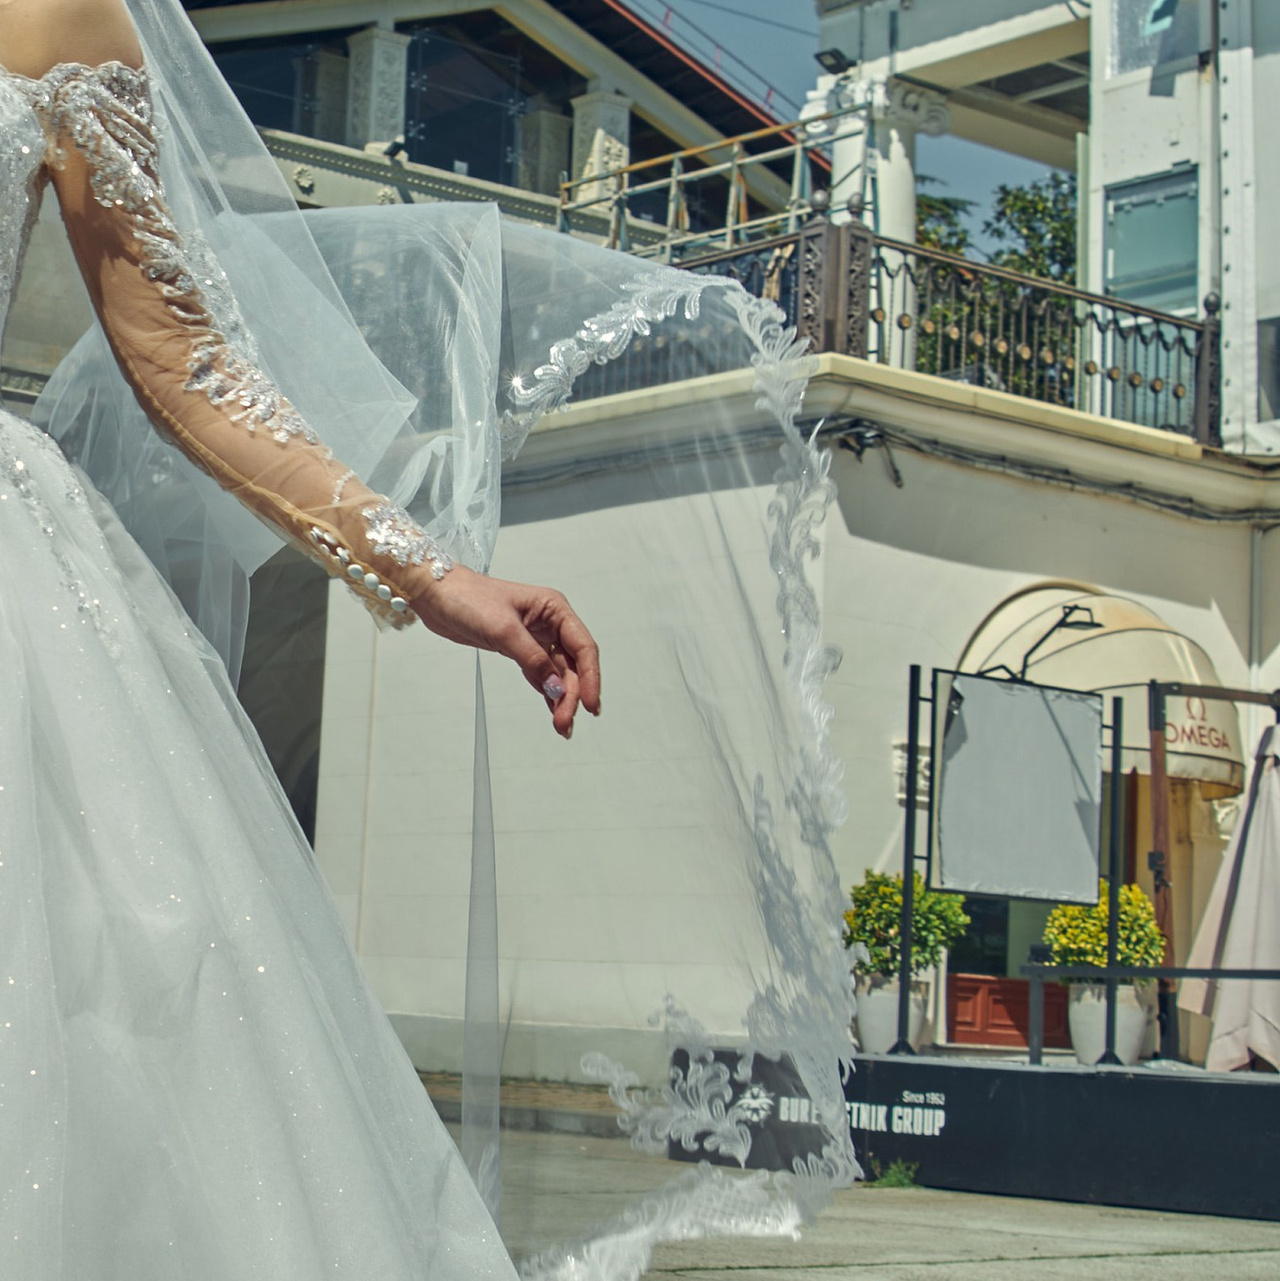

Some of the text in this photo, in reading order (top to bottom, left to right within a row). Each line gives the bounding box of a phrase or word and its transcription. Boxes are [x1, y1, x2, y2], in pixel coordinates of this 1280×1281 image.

[902, 1090, 924, 1104] Since
[779, 1096, 945, 1136] BURETNIK GROUP
